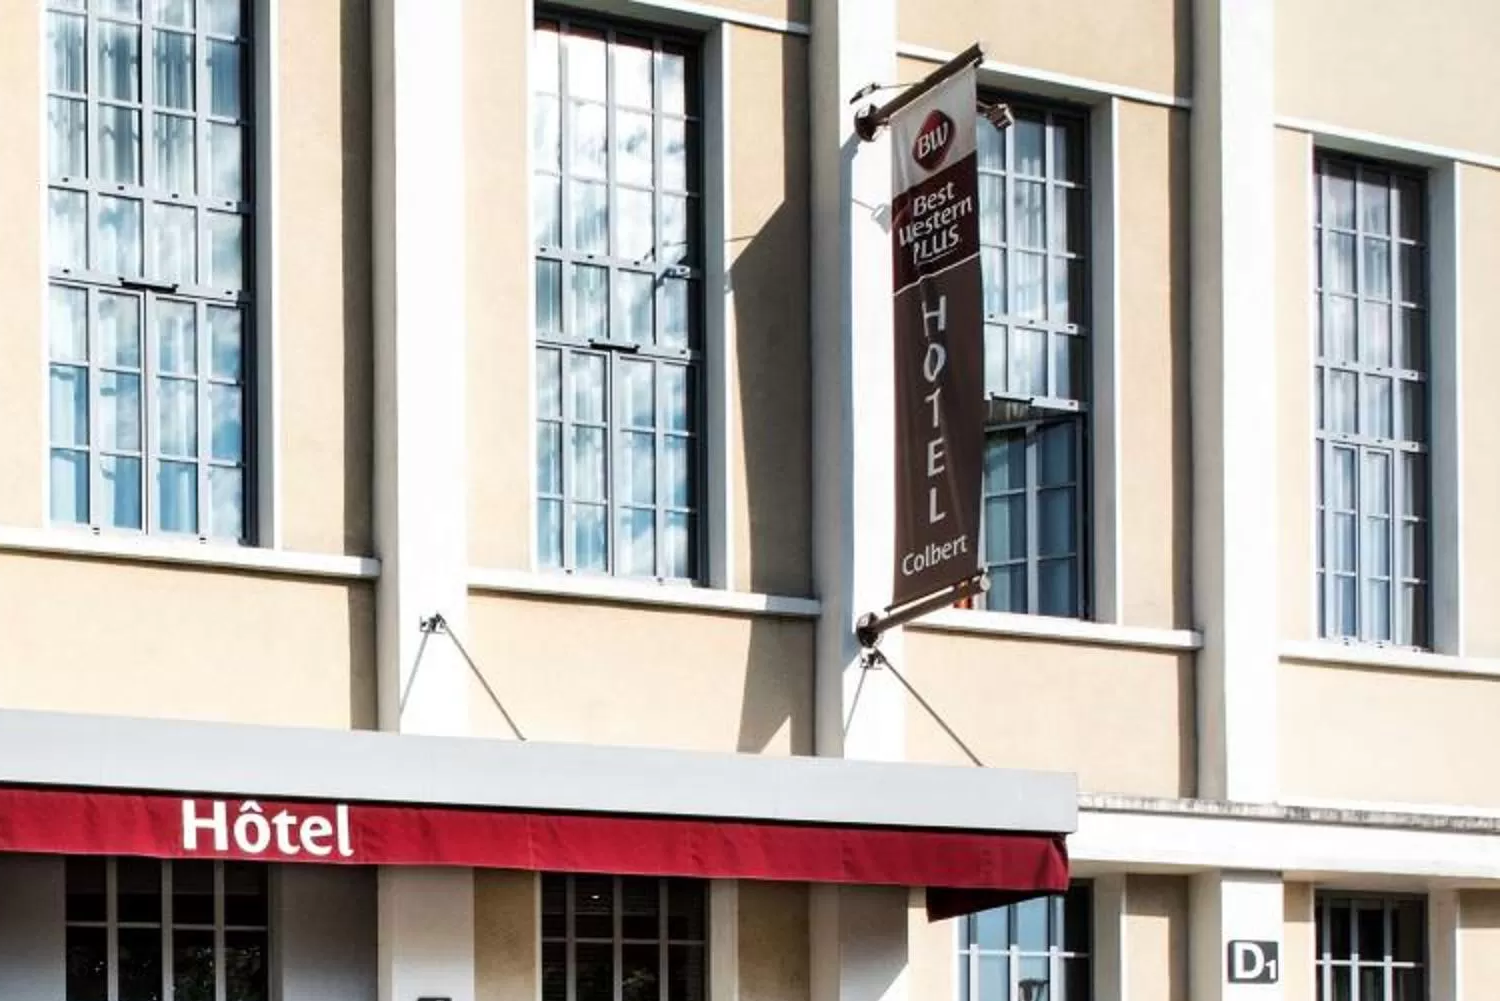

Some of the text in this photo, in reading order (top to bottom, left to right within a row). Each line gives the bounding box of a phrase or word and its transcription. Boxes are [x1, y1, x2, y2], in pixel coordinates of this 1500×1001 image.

[916, 121, 949, 158] BW
[912, 182, 954, 217] Best
[913, 224, 959, 264] PLUS
[921, 295, 946, 524] HOTEL
[902, 534, 968, 577] Colbert
[182, 799, 354, 857] Hôtel
[1234, 942, 1277, 980] D1
